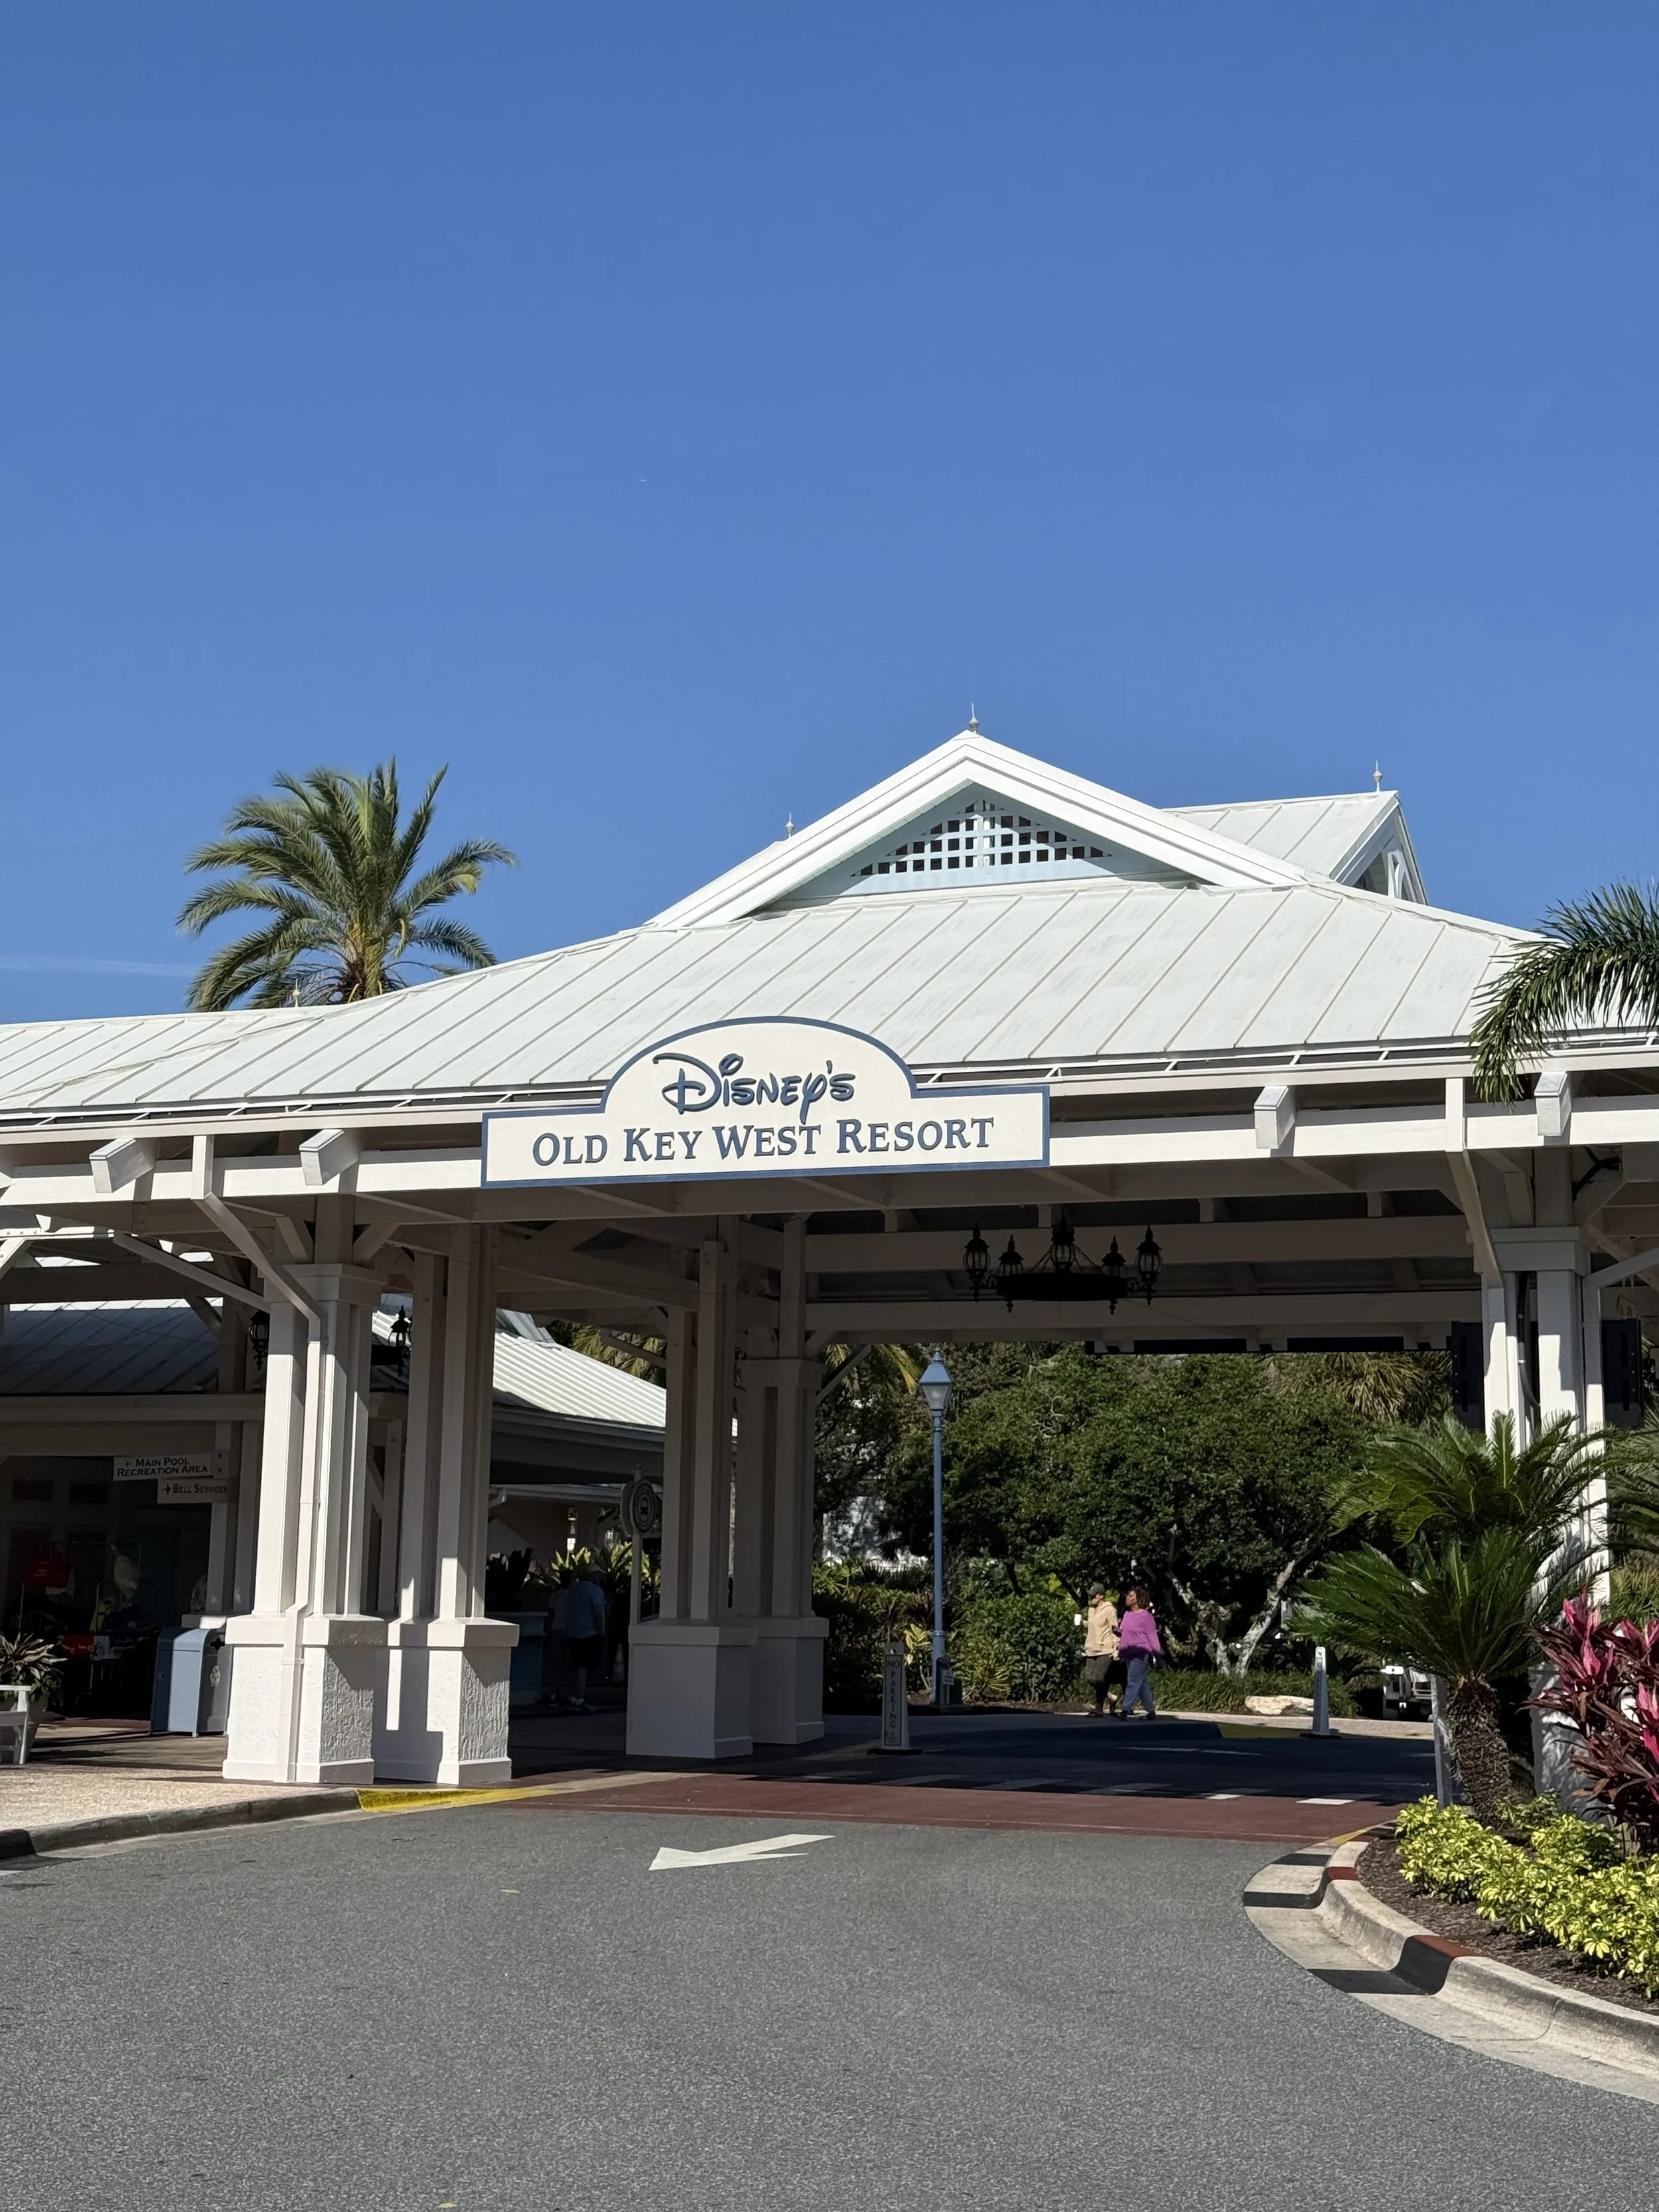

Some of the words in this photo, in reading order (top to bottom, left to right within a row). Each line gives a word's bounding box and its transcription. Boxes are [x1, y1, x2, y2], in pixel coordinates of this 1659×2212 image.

[652, 1053, 856, 1124] Disney's
[532, 1132, 608, 1167] OLD
[623, 1127, 703, 1162] KEY
[712, 1124, 822, 1160] WEST
[836, 1117, 995, 1153] RESORT
[135, 1459, 161, 1467] MAIN
[117, 1467, 179, 1477] RECREATION
[173, 1483, 192, 1494] BELL
[194, 1483, 228, 1494] SERVICES
